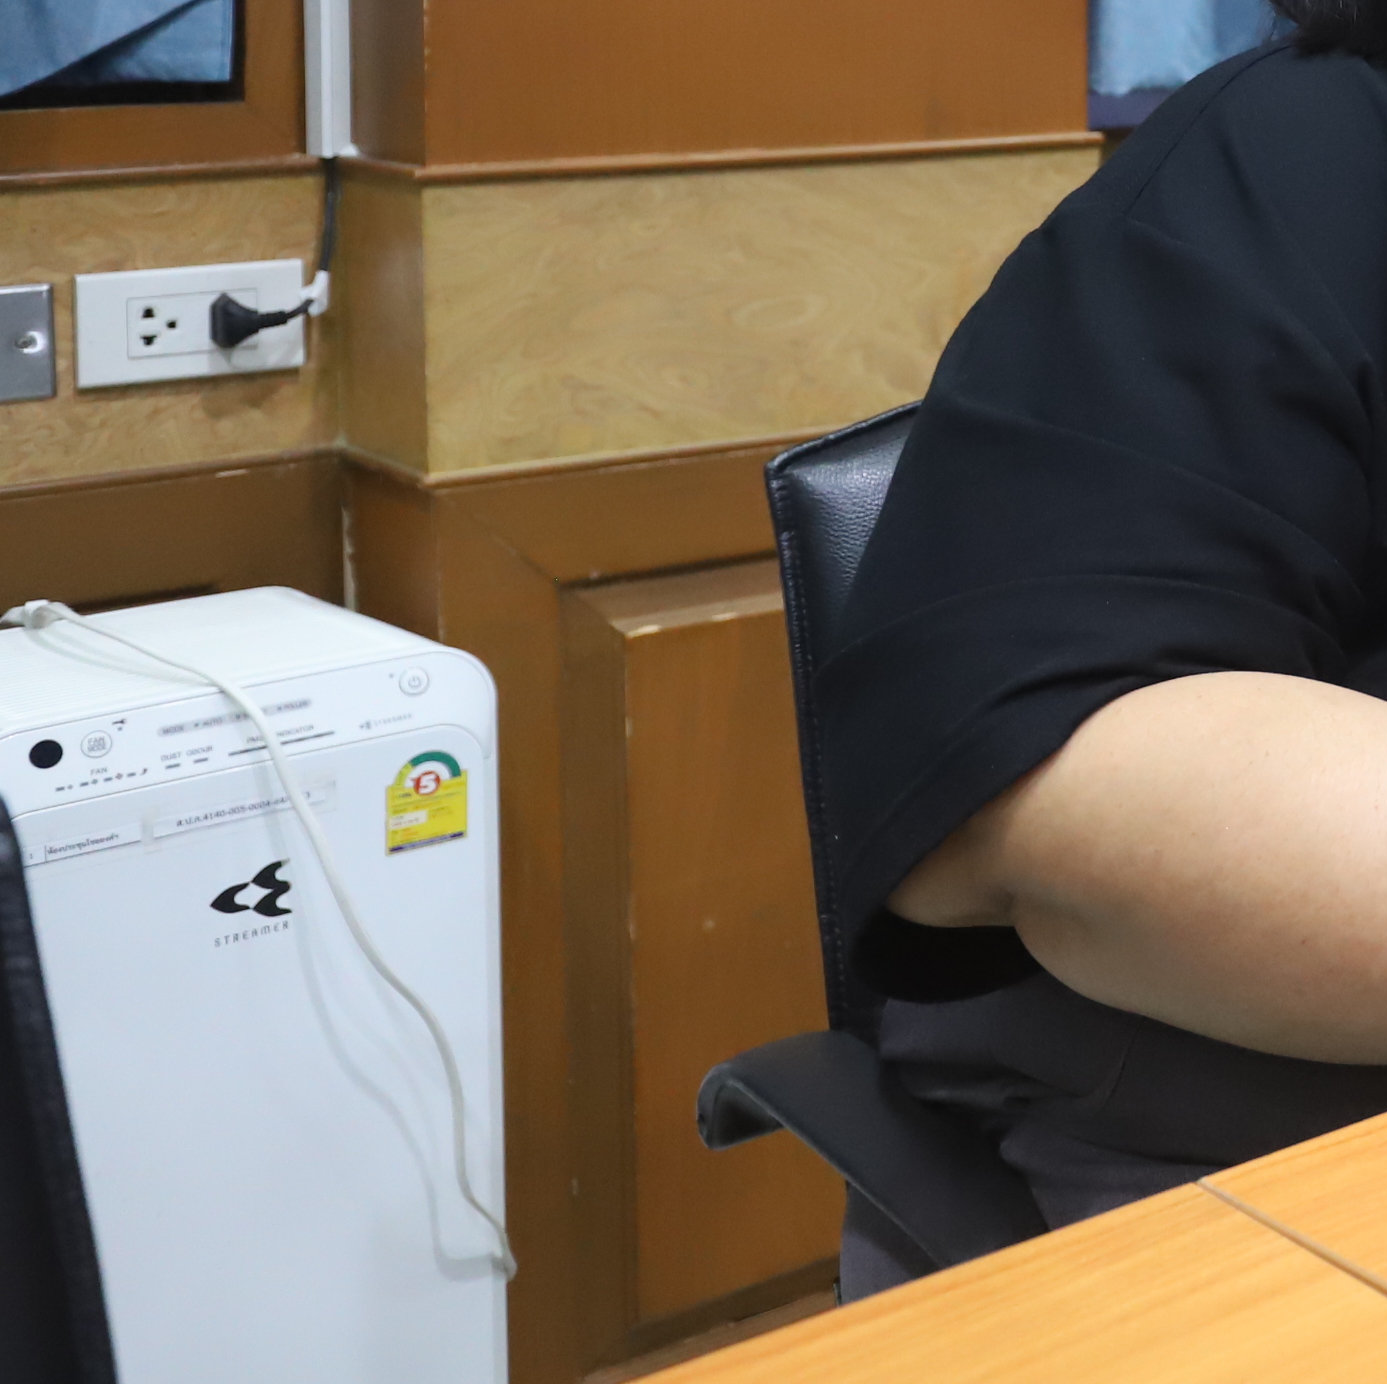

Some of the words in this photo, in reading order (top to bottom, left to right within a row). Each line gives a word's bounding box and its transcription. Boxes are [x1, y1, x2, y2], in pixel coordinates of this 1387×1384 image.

[276, 724, 314, 738] NDICATOR
[90, 767, 108, 776] FAN
[417, 773, 438, 794] 5
[213, 920, 289, 948] STREAMER
